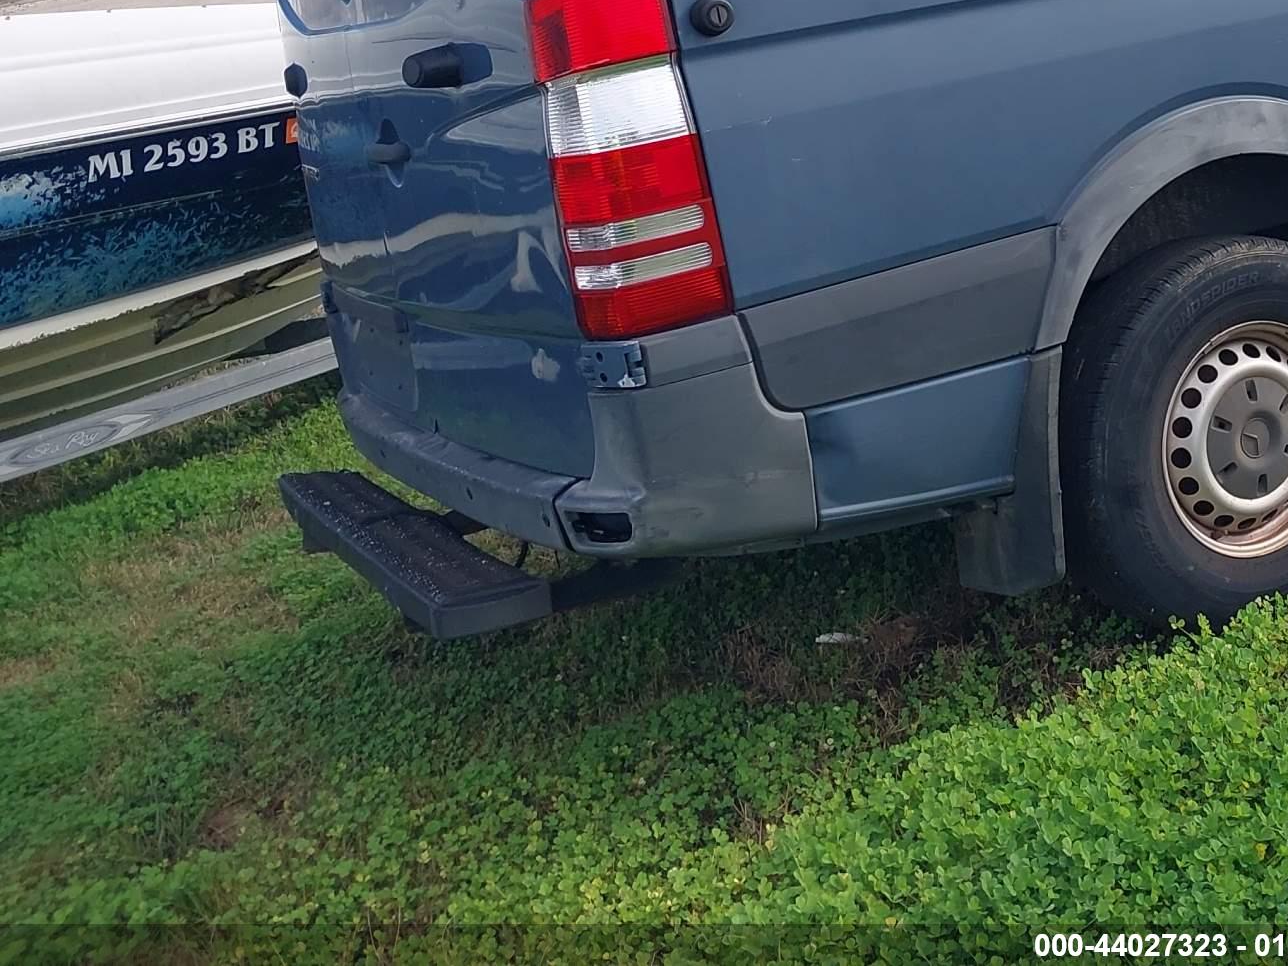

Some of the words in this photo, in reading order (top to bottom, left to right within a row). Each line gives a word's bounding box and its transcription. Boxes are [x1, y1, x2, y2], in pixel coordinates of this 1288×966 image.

[88, 148, 134, 183] MI
[143, 132, 228, 173] 2593
[237, 121, 280, 154] BT
